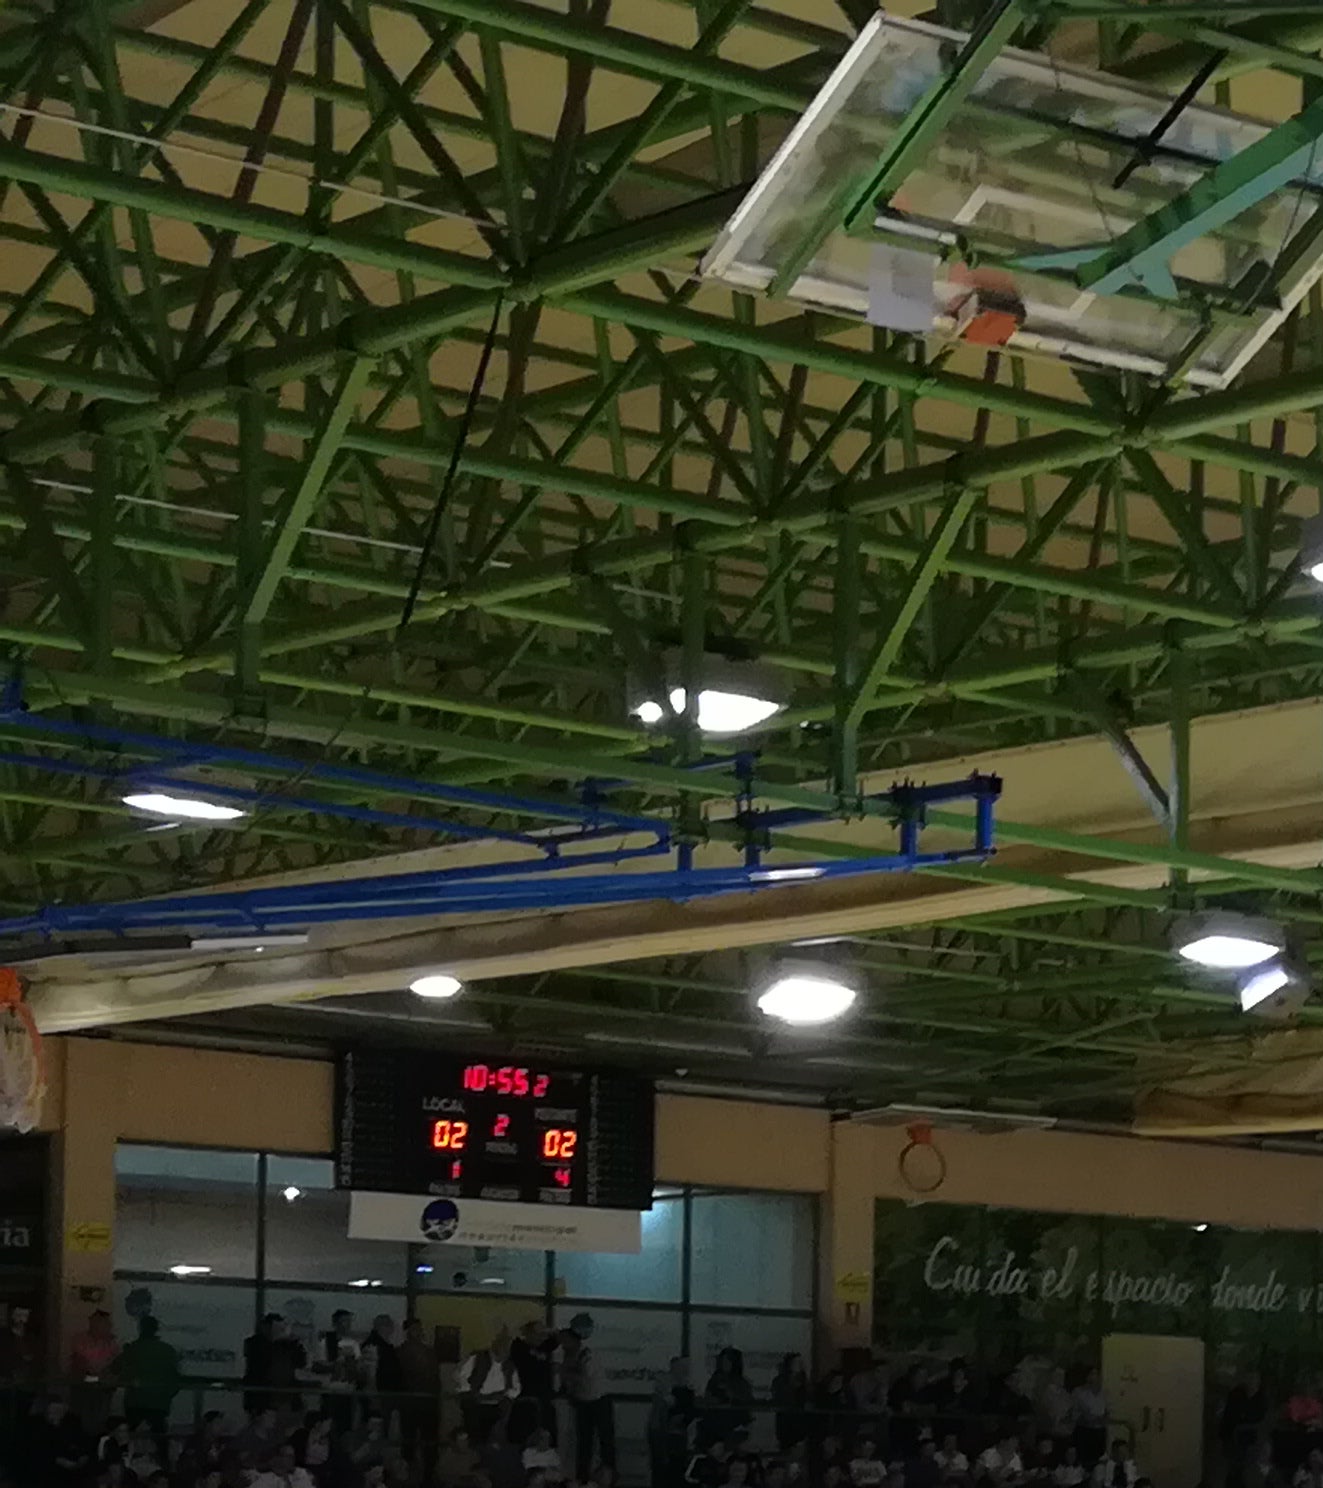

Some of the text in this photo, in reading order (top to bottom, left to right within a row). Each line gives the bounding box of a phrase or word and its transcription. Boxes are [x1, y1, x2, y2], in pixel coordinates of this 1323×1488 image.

[433, 1119, 469, 1149] 02
[543, 1128, 578, 1158] 02
[923, 1235, 1029, 1297] Cuida
[1041, 1247, 1079, 1300] el
[1085, 1270, 1194, 1319] espacio
[1211, 1264, 1289, 1312] donde
